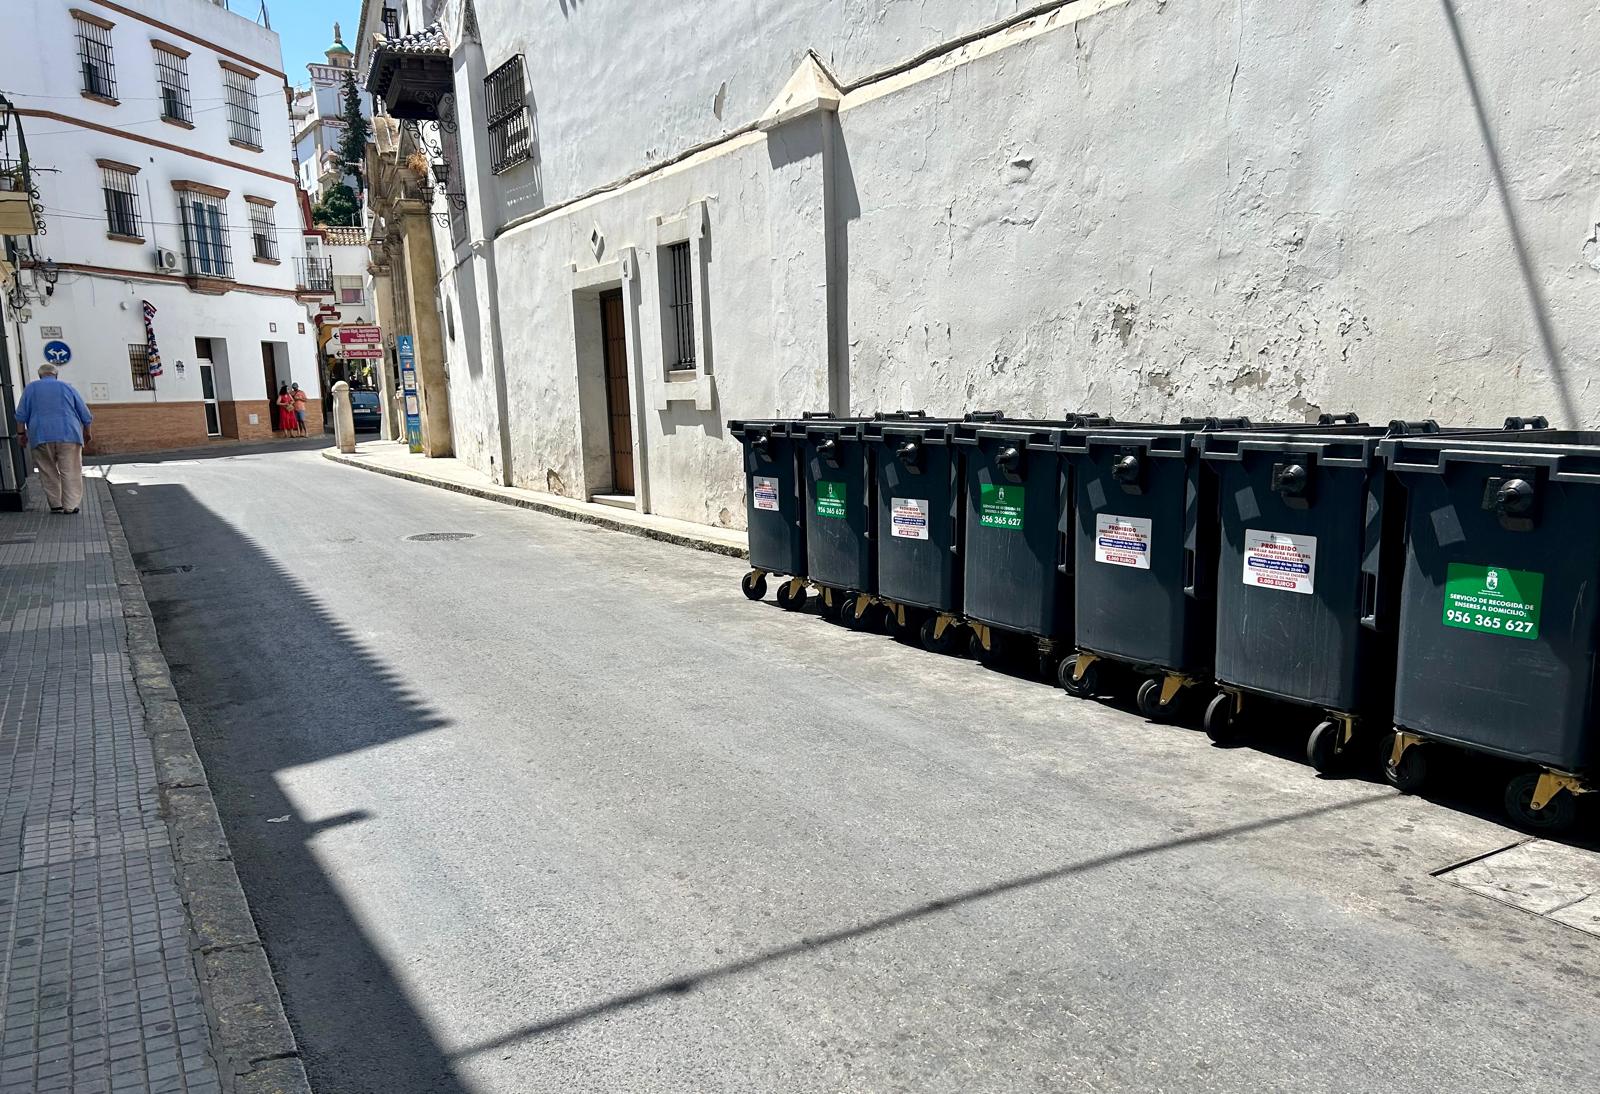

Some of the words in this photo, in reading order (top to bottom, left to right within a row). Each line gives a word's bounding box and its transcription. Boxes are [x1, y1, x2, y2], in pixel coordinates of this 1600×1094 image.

[982, 515, 993, 523] 956
[1261, 543, 1297, 551] PROHIBIDO
[1450, 594, 1477, 603] SERVICIO
[1489, 599, 1523, 609] RECOGIDA
[1454, 601, 1480, 610] ENSERES
[1447, 610, 1470, 623] 956
[1474, 614, 1500, 628] 365
[1505, 620, 1534, 632] 627
